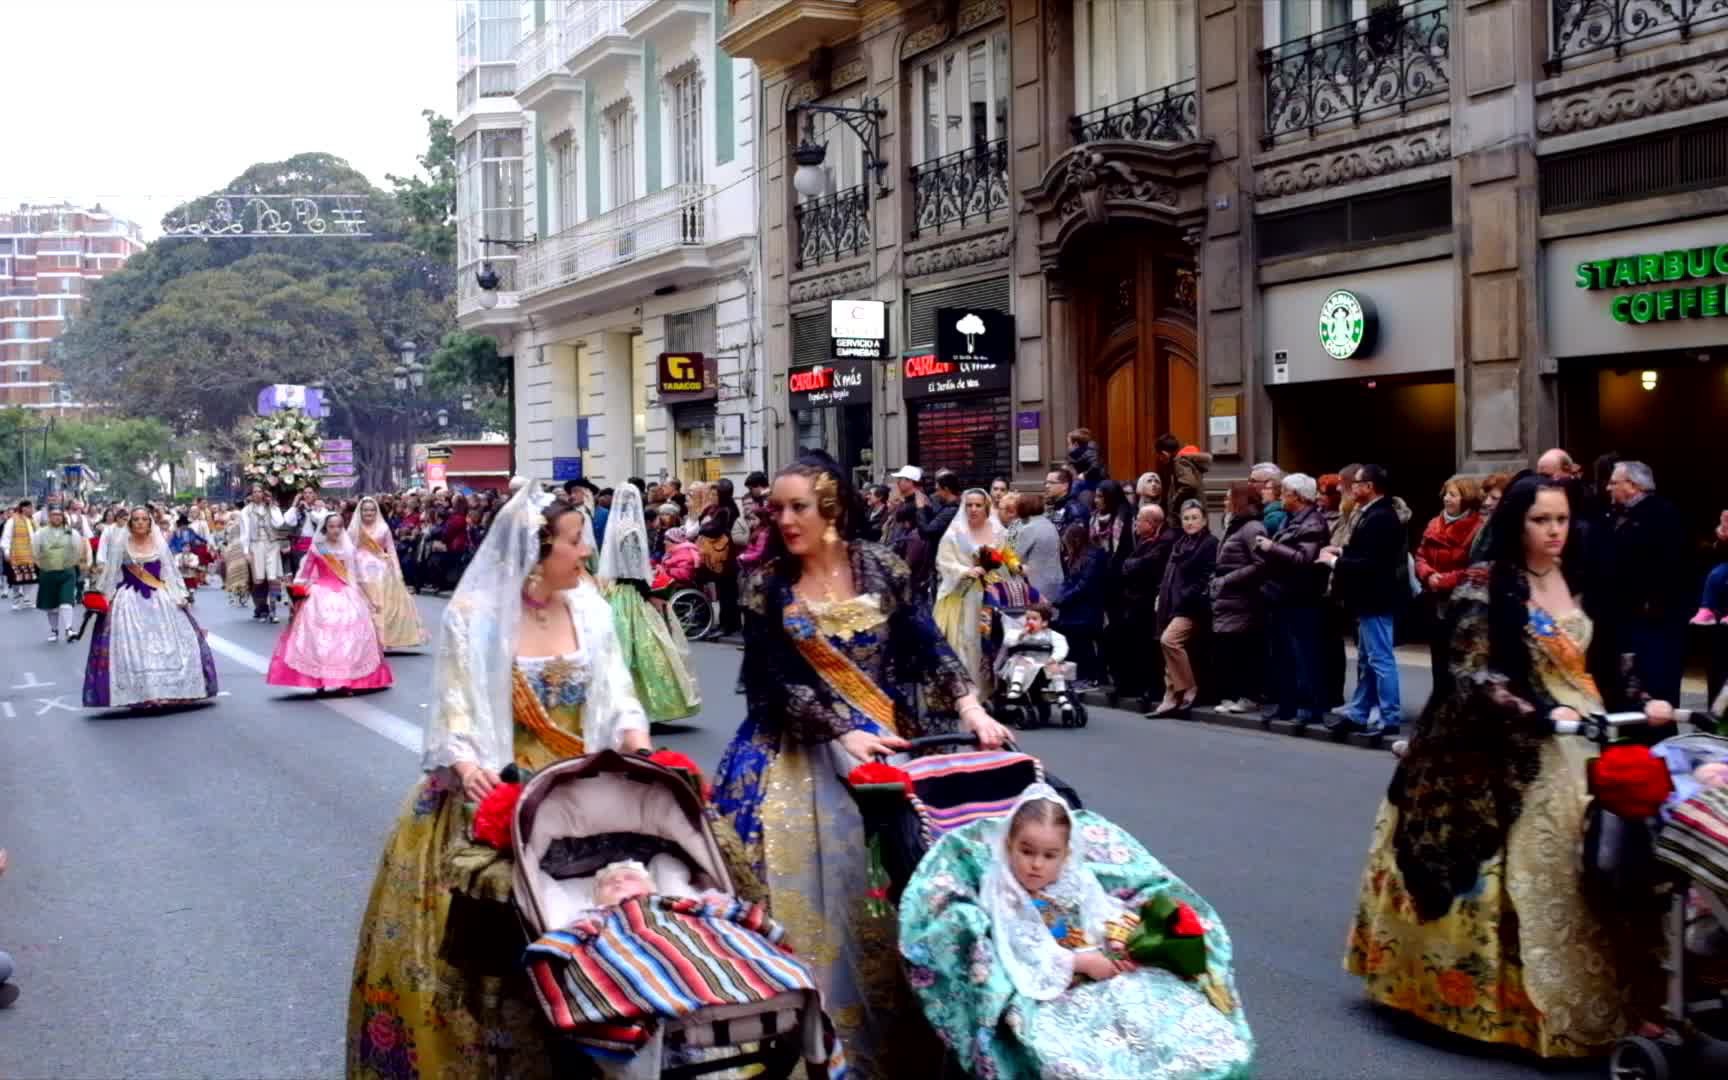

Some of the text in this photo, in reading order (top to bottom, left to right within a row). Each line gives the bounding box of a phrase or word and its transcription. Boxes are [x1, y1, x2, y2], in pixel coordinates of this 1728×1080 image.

[1611, 283, 1728, 324] COFFE
[836, 338, 881, 348] SERVICIO A
[836, 347, 881, 357] EMPRESAS
[842, 367, 862, 387] más
[663, 382, 702, 391] TABACOS
